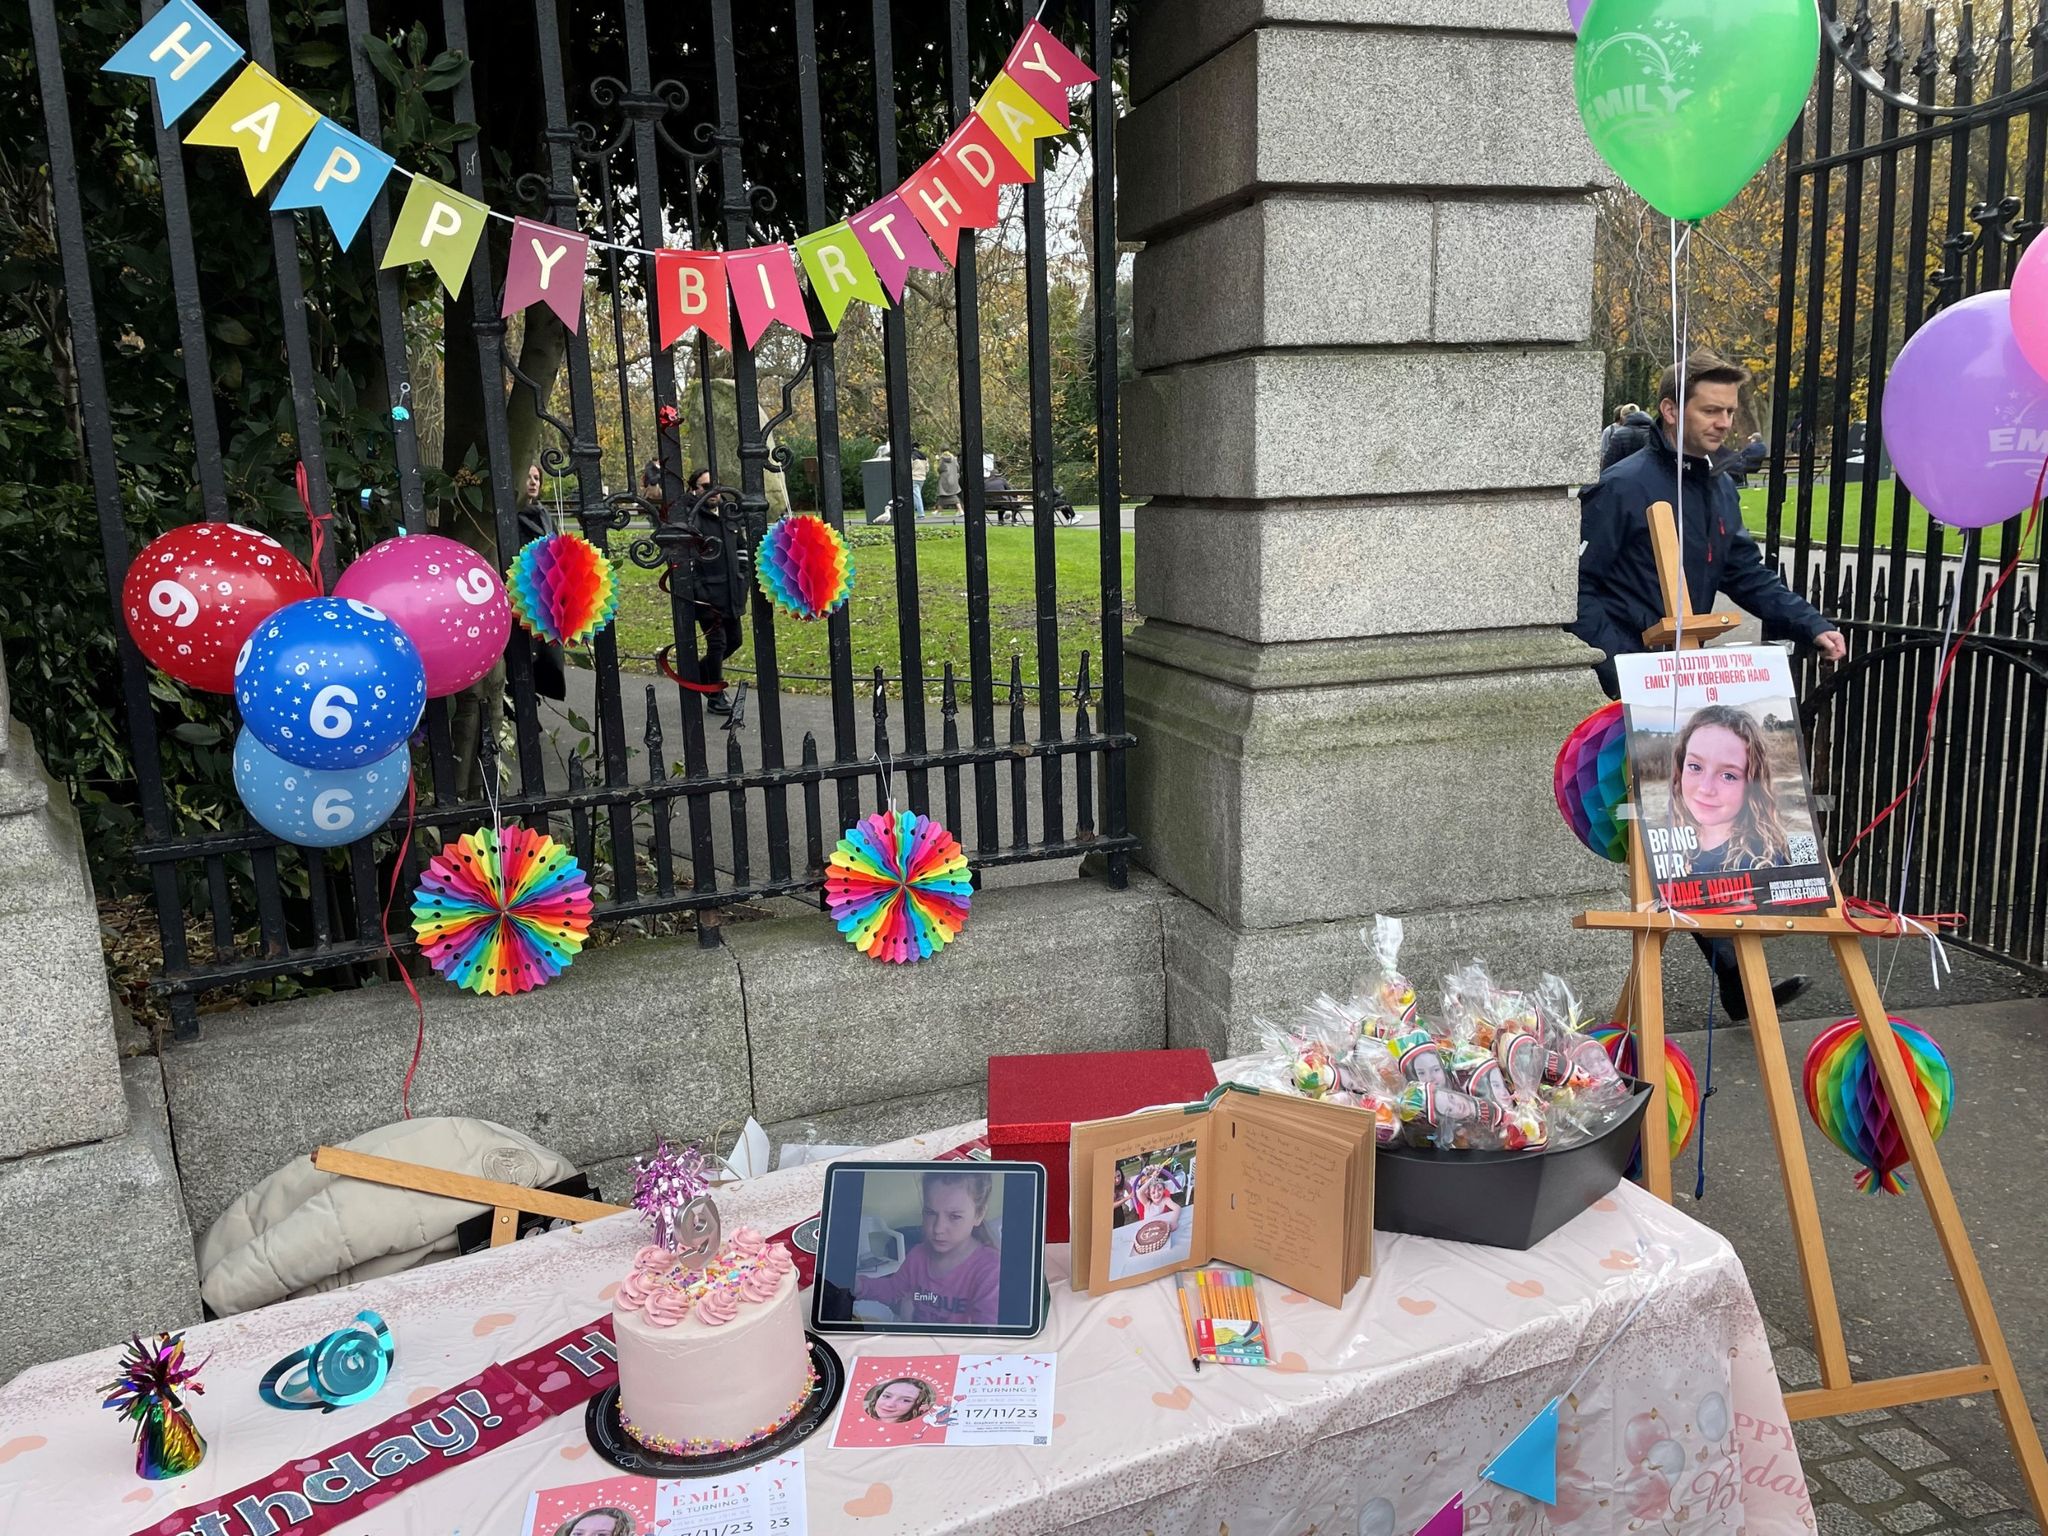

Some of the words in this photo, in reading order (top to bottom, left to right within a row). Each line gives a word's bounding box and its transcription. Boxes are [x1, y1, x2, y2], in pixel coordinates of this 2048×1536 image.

[149, 21, 567, 290] HAPPY
[678, 42, 1062, 314] BIRTHDAY
[149, 580, 199, 627] 9
[1644, 674, 1670, 689] EMILY
[1697, 671, 1746, 686] KORENBERG
[1747, 668, 1770, 682] HAND
[1657, 881, 1706, 908] HOME
[1706, 872, 1755, 904] NOW!
[914, 1292, 938, 1304] Emily
[965, 1407, 1038, 1419] 17/11/23
[687, 1499, 739, 1513] TURNING
